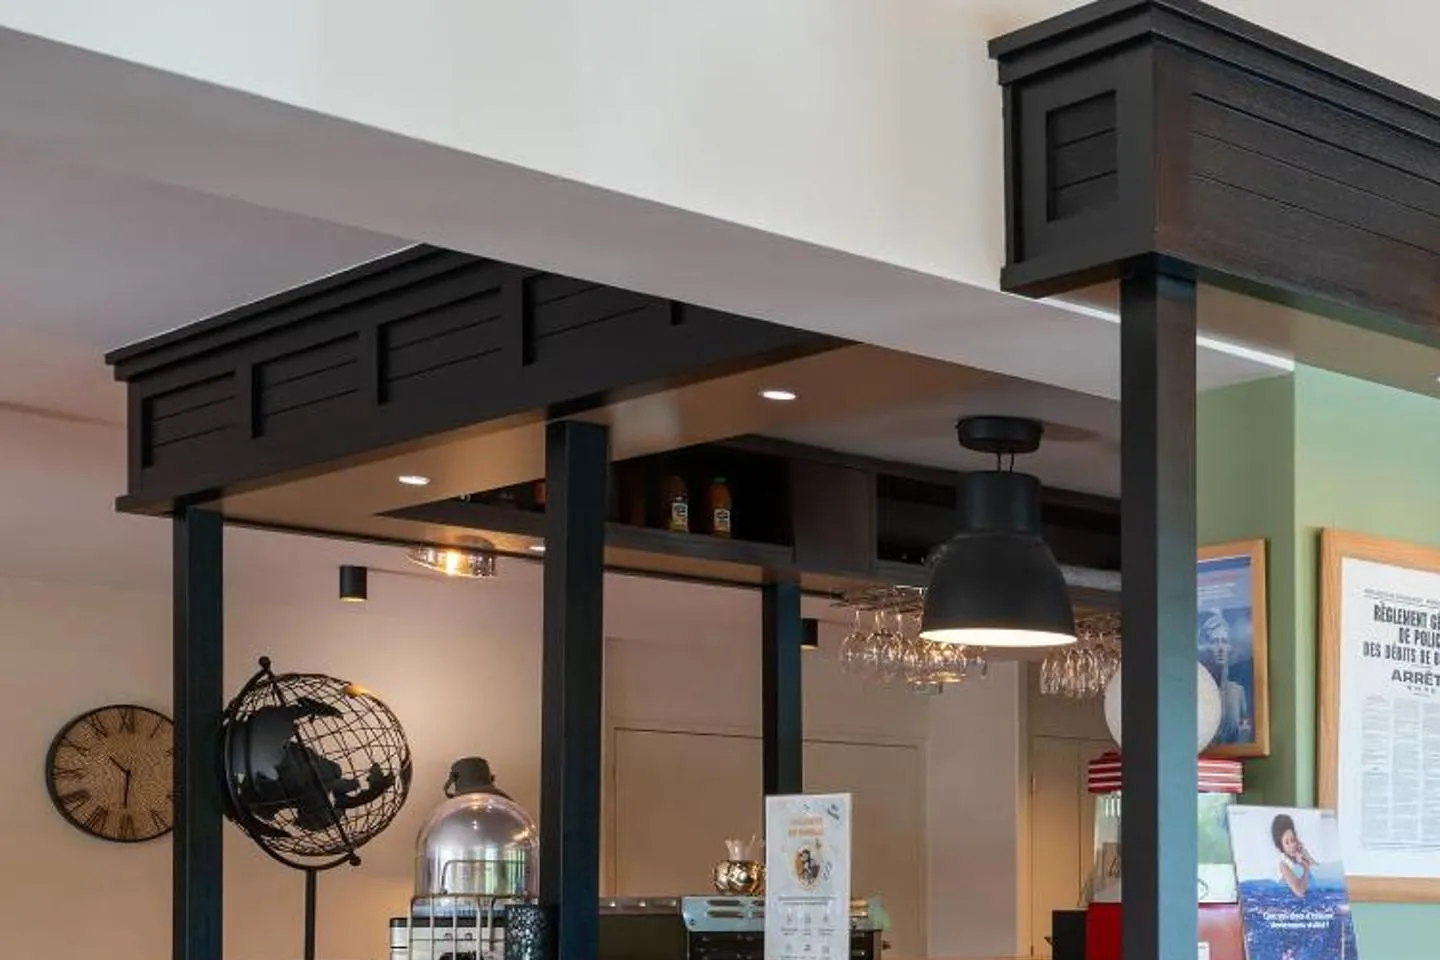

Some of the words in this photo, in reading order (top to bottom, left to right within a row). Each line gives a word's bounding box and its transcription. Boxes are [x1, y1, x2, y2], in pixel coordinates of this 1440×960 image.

[1374, 602, 1427, 628] RÈGLEMENT
[1399, 627, 1411, 644] DE
[1363, 641, 1381, 657] DES
[1384, 641, 1416, 662] DÉBITS
[1420, 650, 1431, 664] DE
